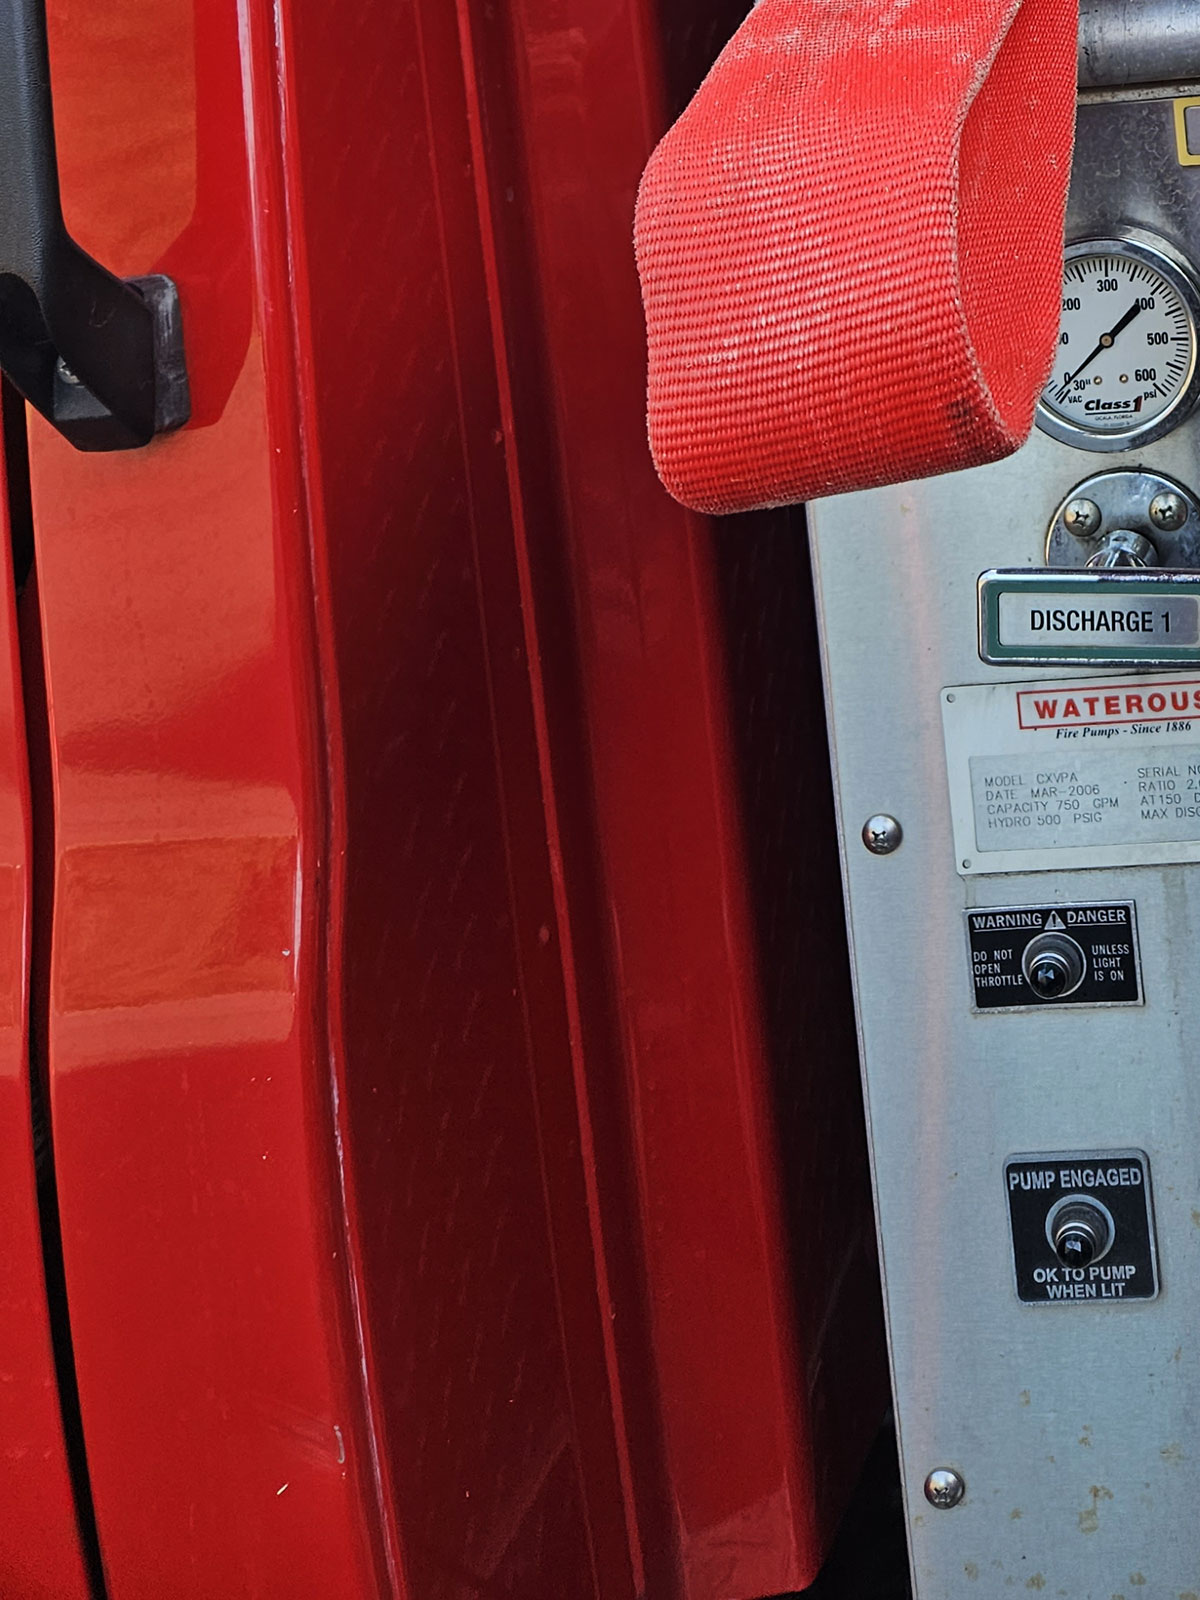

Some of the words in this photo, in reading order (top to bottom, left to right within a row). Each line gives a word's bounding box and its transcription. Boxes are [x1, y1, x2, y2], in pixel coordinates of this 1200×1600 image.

[1097, 278, 1118, 292] 300
[1147, 332, 1168, 346] 500
[1064, 372, 1071, 385] 0
[1135, 368, 1156, 382] 600
[1068, 395, 1082, 404] VAC
[1143, 389, 1157, 401] psi
[1031, 610, 1153, 632] DISCHARGE
[1161, 611, 1170, 632] 1
[1056, 728, 1079, 739] Fire
[1083, 726, 1120, 739] Pumps
[1130, 723, 1161, 735] Since
[1165, 720, 1192, 733] 1886
[984, 774, 1025, 787] MODEL
[1036, 772, 1078, 785] CXVPA
[1137, 766, 1181, 779] SERIAL
[986, 789, 1018, 801] DATE
[1031, 784, 1100, 798] MAR-2006
[1138, 780, 1176, 792] RATIO
[987, 801, 1049, 815] CAPACITY
[1056, 799, 1080, 811] 750
[1093, 797, 1119, 809] GPM
[988, 816, 1031, 828] HYDRO
[1037, 814, 1061, 826] 500
[1073, 812, 1102, 823] PSIG
[1141, 808, 1168, 819] MAX
[973, 913, 1042, 929] WARNING
[1067, 909, 1126, 923] DANGER
[973, 951, 987, 962] DO
[994, 949, 1013, 960] NOT
[1091, 944, 1129, 955] UNLESS
[974, 963, 1000, 975] OPEN
[1093, 957, 1121, 968] LIGHT
[975, 974, 1023, 987] THROTTLE
[1094, 971, 1104, 981] IS
[1110, 970, 1124, 981] ON
[1009, 1171, 1055, 1190] PUMP
[1060, 1167, 1142, 1188] ENGAGED
[1033, 1267, 1059, 1283] OK
[1062, 1267, 1085, 1282] TO
[1089, 1265, 1136, 1281] PUMP
[1046, 1284, 1096, 1299] WHEN
[1101, 1283, 1125, 1297] LIT
